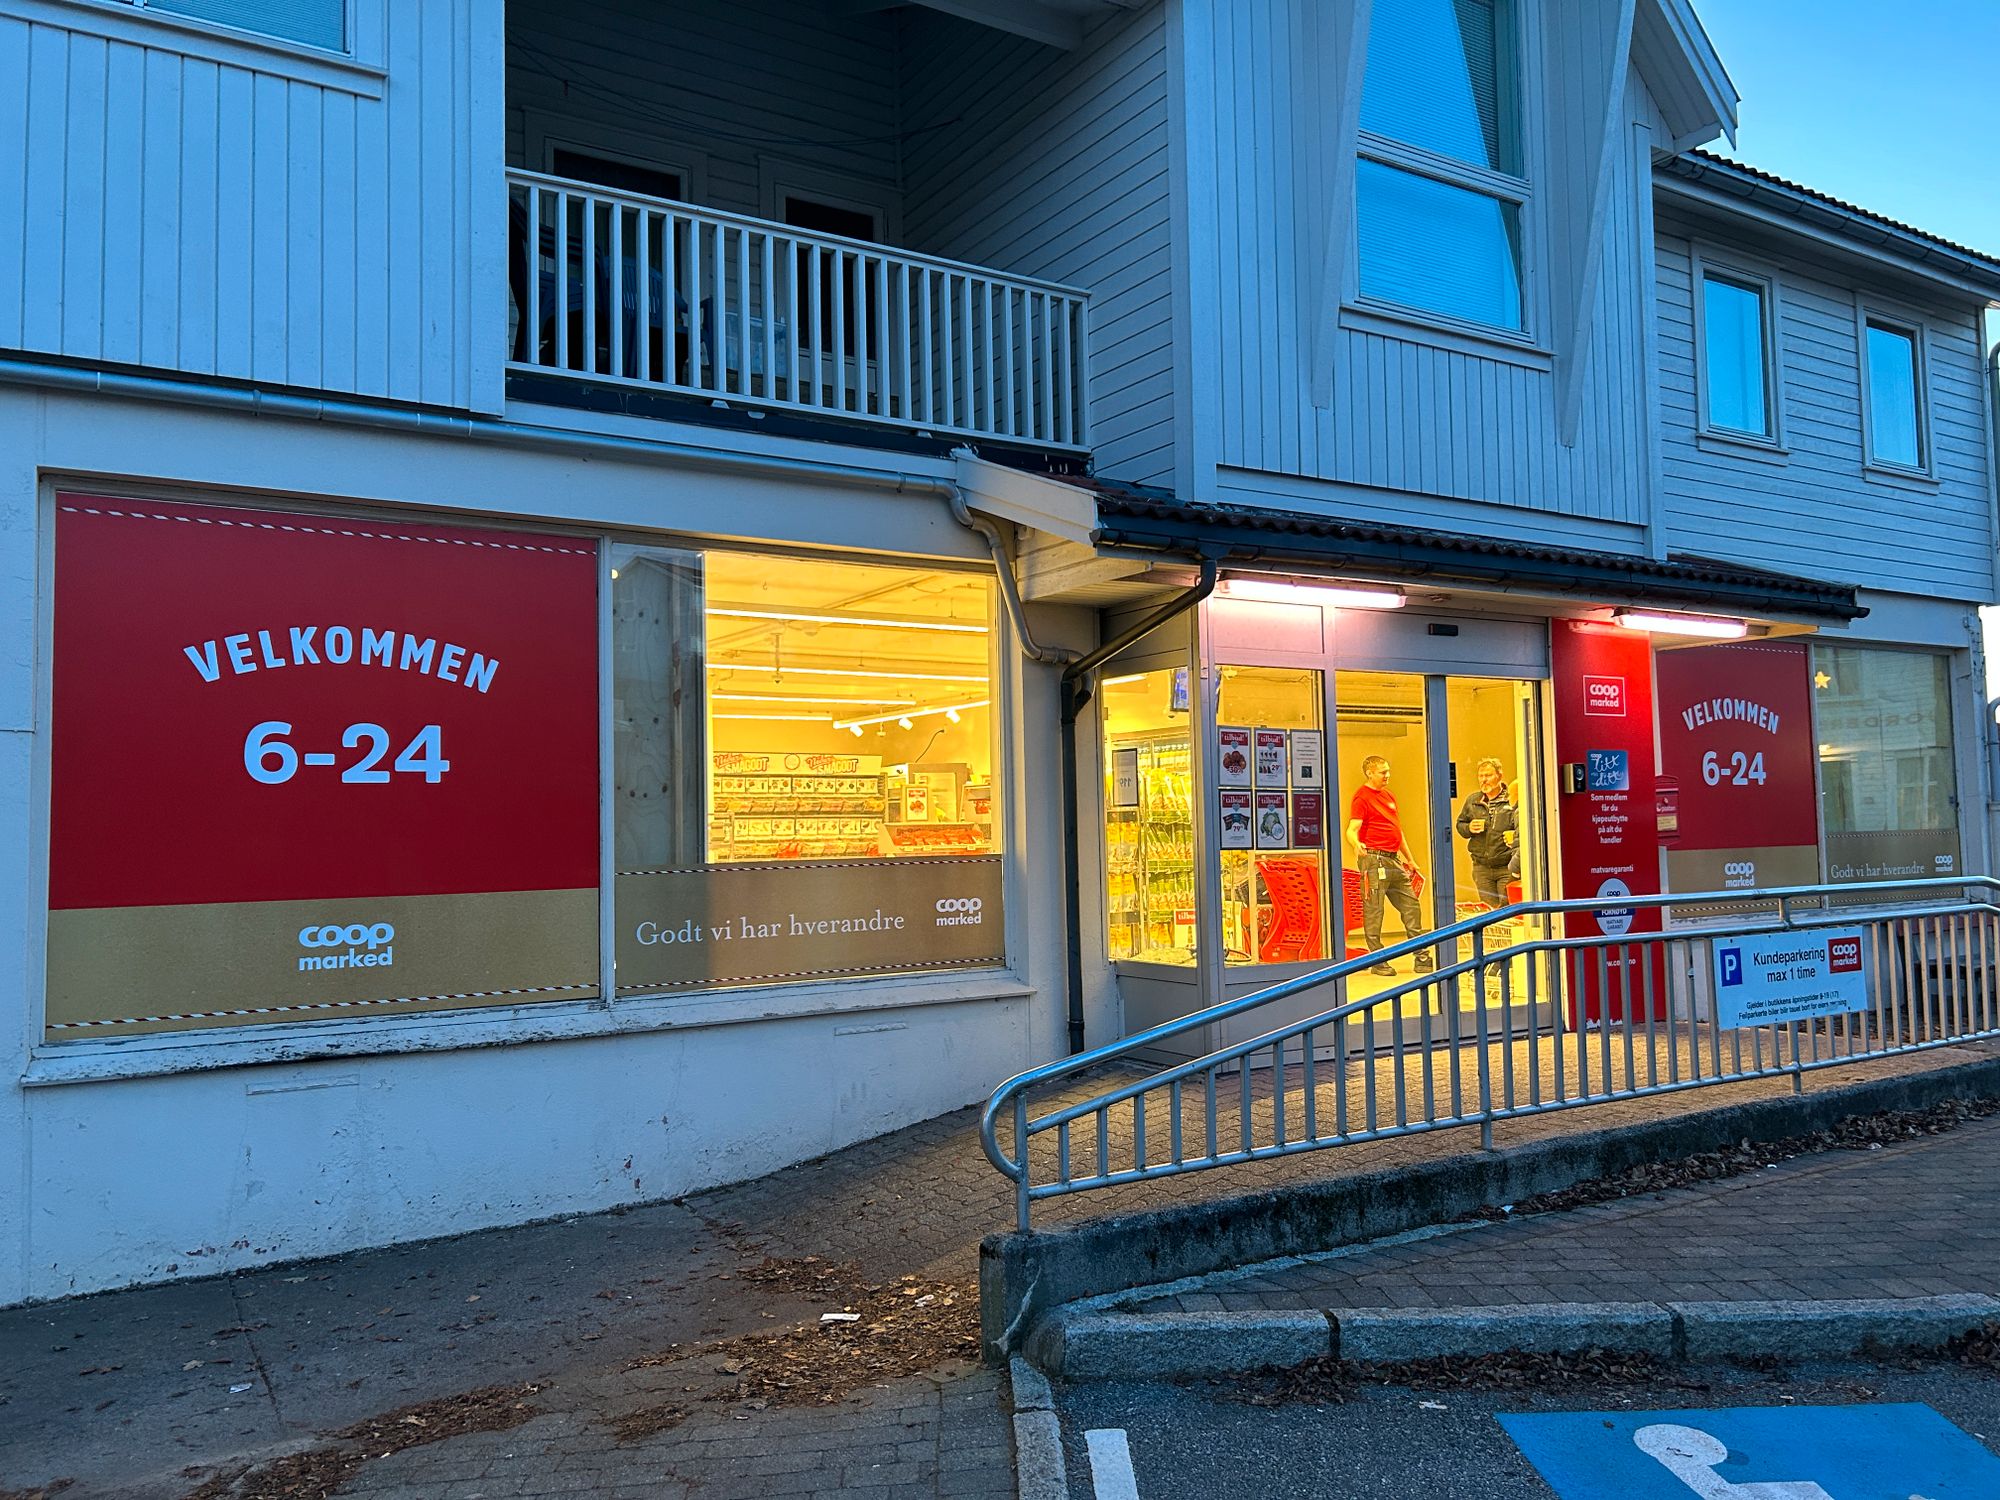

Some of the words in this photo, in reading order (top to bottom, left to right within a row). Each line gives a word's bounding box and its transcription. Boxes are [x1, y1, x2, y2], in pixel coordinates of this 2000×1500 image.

[184, 626, 499, 694] VELKOMMEN
[1590, 684, 1619, 698] coop
[1590, 698, 1619, 708] marked
[1682, 698, 1780, 735] VELKOMMEN
[243, 720, 450, 785] 6-24
[1702, 751, 1767, 786] 6-24
[1590, 793, 1604, 801] Som
[1604, 793, 1628, 801] medlem
[1610, 804, 1618, 812] du
[1598, 826, 1606, 835] på
[1600, 835, 1622, 844] handler
[1935, 854, 1953, 864] coop
[1590, 864, 1634, 874] matvaregaranti
[1725, 862, 1754, 876] coop
[1831, 864, 1854, 879] Godt
[1856, 864, 1864, 877] vi
[1866, 863, 1881, 876] har
[1883, 861, 1925, 876] hverandre
[1725, 875, 1755, 887] marked
[936, 898, 982, 914] coop
[936, 912, 982, 926] marked
[636, 920, 703, 946] Godt
[710, 920, 732, 942] vi
[739, 915, 782, 940] har
[788, 909, 905, 937] hverandre
[299, 923, 394, 951] coop
[1832, 943, 1857, 956] coop
[299, 948, 393, 972] marked
[1753, 948, 1825, 966] Kundeparkering
[1833, 955, 1857, 967] marked
[1725, 954, 1737, 981] P
[1767, 971, 1787, 982] max
[1790, 969, 1795, 980] 1
[1797, 967, 1816, 979] time
[1746, 1000, 1764, 1009] Gjelder
[1768, 998, 1791, 1006] butikkens
[1738, 1009, 1767, 1020] Feilparkerte
